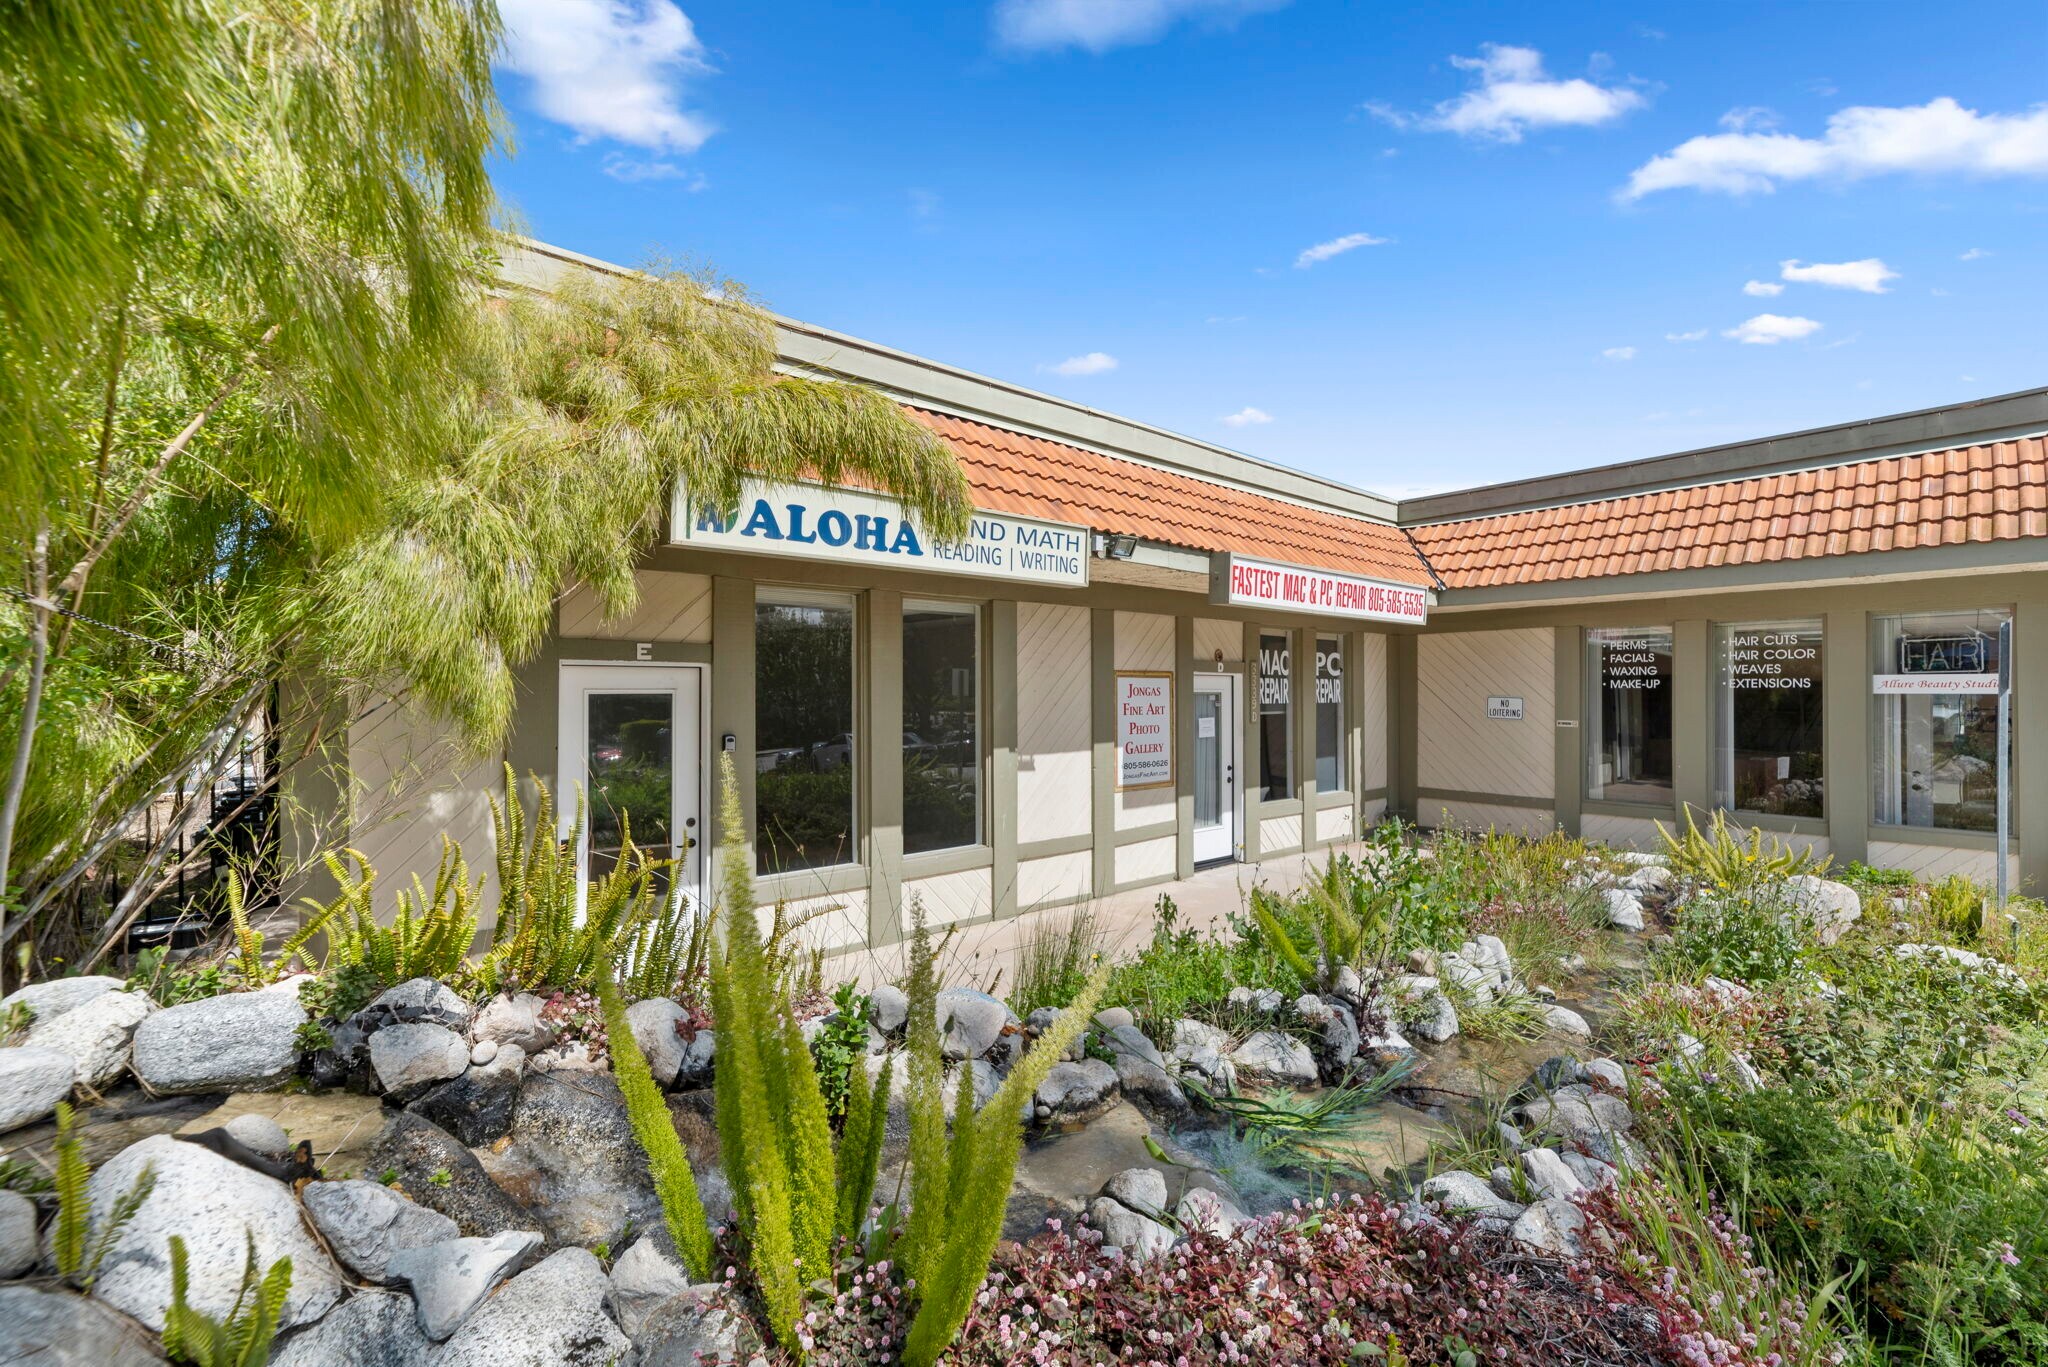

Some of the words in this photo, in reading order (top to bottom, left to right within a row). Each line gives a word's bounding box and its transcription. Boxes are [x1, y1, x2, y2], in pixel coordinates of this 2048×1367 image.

[740, 498, 924, 557] ALOHA
[969, 519, 1006, 542] ND
[1016, 526, 1080, 553] MATH
[933, 539, 1001, 566] READING
[1019, 550, 1078, 575] WRITING
[1231, 565, 1281, 600] FASTEST
[1283, 573, 1307, 604] MAC
[1309, 578, 1317, 604] &
[1320, 579, 1333, 607] PC
[1336, 582, 1367, 610] REPAIR
[1368, 586, 1424, 617] 805-585-5535
[1610, 640, 1647, 650] PERMS
[1728, 636, 1759, 646] HAIR
[1763, 634, 1798, 646] CUTS
[636, 642, 652, 660] E
[1610, 653, 1655, 663] FACIALS
[1728, 650, 1759, 660] HAIR
[1763, 648, 1816, 660] COLOR
[1906, 642, 1980, 670] HAIR
[1217, 662, 1224, 673] D
[1260, 649, 1290, 677] MAC
[1315, 651, 1341, 677] PC
[1728, 663, 1782, 674] WEAVES
[1610, 666, 1658, 676] WAXING
[1610, 679, 1661, 689] MAKE-UP
[1728, 677, 1812, 689] EXTENSIONS
[1878, 679, 1915, 690] Allure
[1918, 679, 1960, 691] Beauty
[1127, 683, 1161, 699] JONGAS
[1260, 677, 1290, 704] REPAIR
[1315, 678, 1341, 703] REPAIR
[1123, 702, 1144, 716] FINE
[1146, 702, 1166, 716] ART
[1500, 700, 1510, 708] NO
[1489, 708, 1521, 718] LOITERING
[1129, 722, 1160, 736] PHOTO
[1125, 741, 1165, 755] GALLERY
[1123, 760, 1168, 770] 805-586-0626
